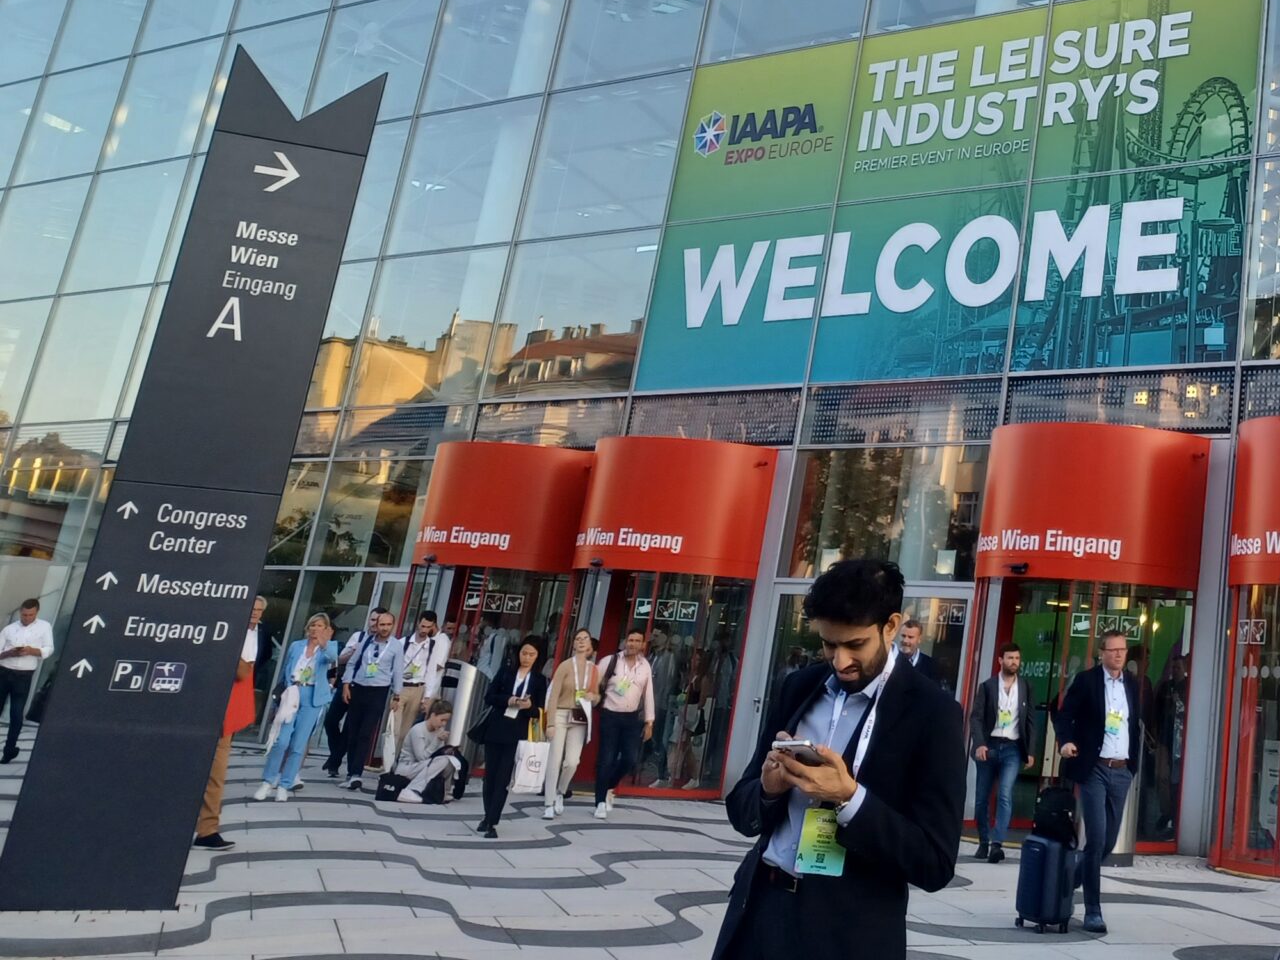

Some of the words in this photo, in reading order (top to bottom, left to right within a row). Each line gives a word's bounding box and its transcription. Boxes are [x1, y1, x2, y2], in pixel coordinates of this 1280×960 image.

[868, 50, 959, 102] THE
[969, 11, 1193, 88] LEISURE
[857, 69, 1160, 152] INDUSTRY'S
[724, 146, 765, 166] EXPO
[768, 136, 834, 160] EUROPE
[853, 154, 907, 173] PREMIER
[911, 149, 953, 166] EVENT
[957, 147, 971, 160] IN
[974, 138, 1030, 158] EUROPE
[236, 221, 299, 246] Messe
[230, 245, 279, 269] Wien
[683, 197, 1184, 329] WELCOME
[222, 270, 297, 301] Eingang
[206, 296, 242, 341] A
[156, 503, 248, 530] Congress
[149, 531, 216, 554] Center
[423, 526, 447, 543] Wien
[450, 526, 510, 551] Eingang
[586, 528, 615, 546] Wien
[617, 527, 683, 554] Eingang
[1001, 529, 1040, 551] Wien
[1045, 529, 1121, 560] Eingang
[136, 573, 249, 600] Messeturm
[124, 616, 207, 644] Eingang
[213, 621, 229, 641] D
